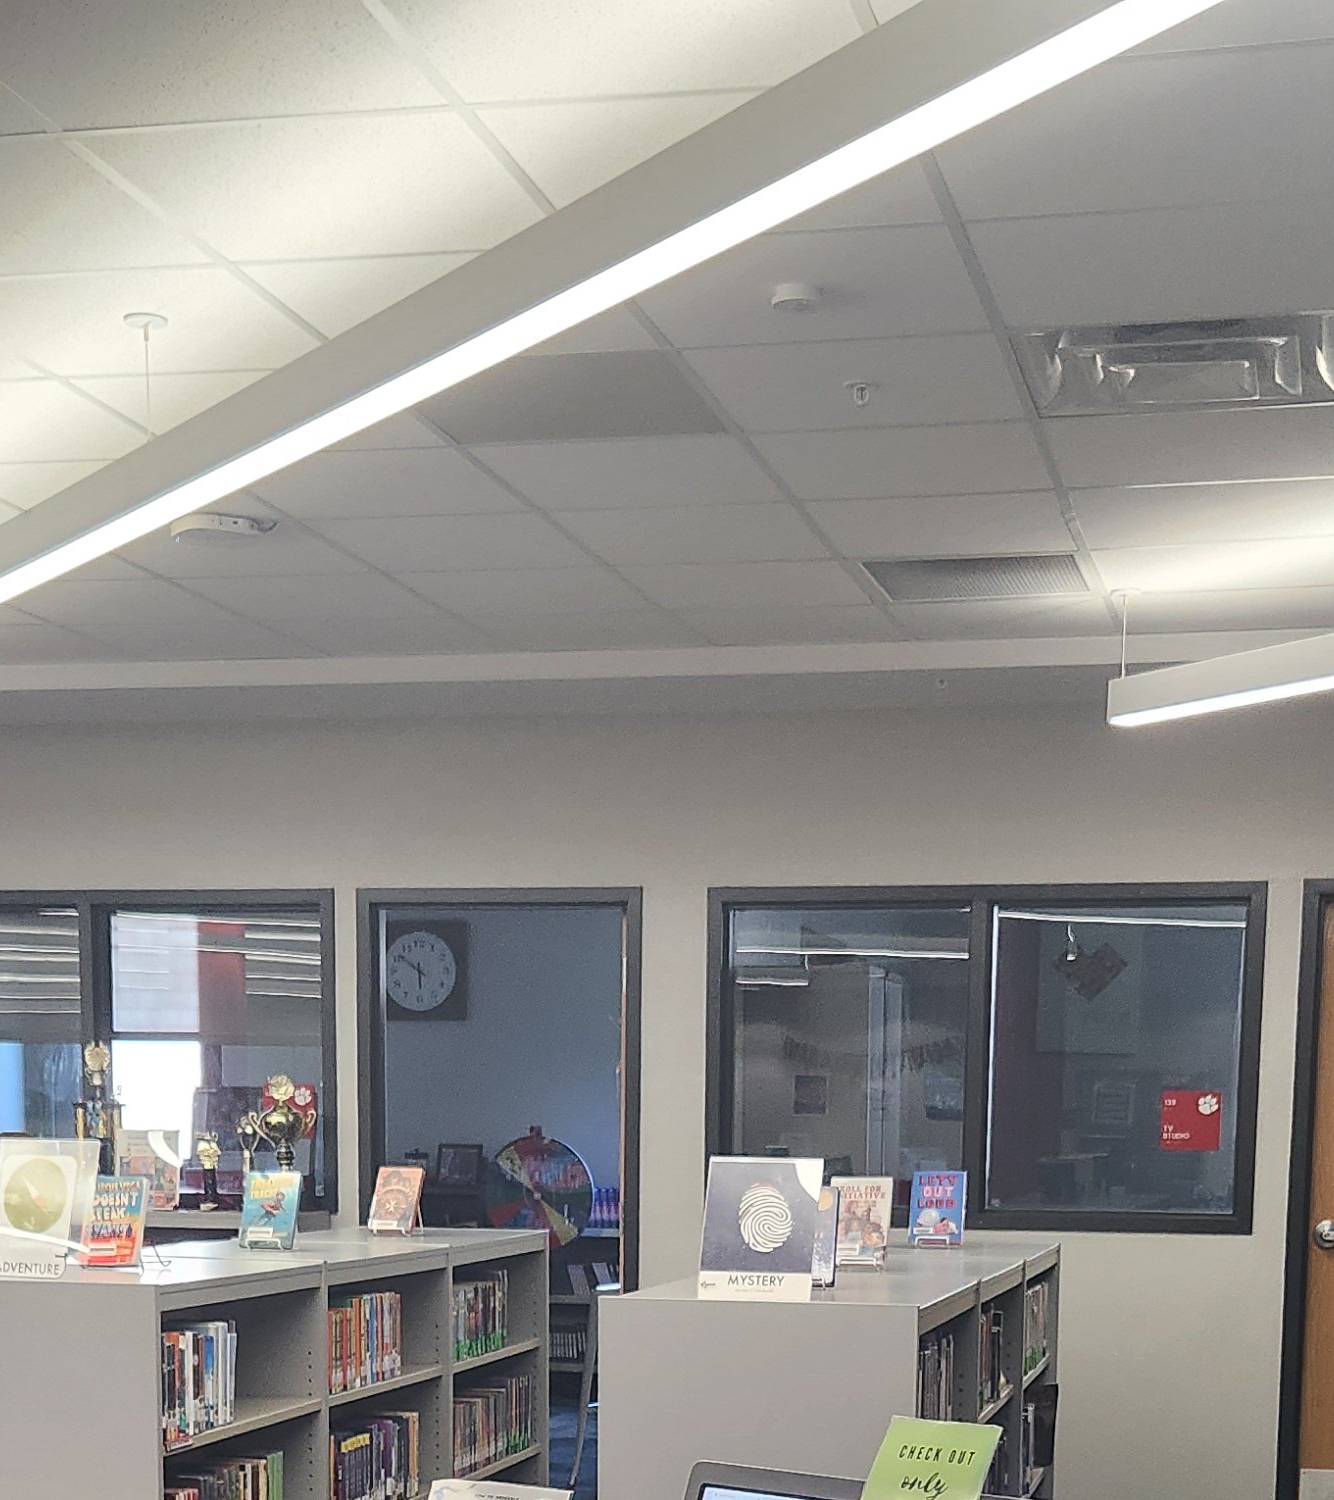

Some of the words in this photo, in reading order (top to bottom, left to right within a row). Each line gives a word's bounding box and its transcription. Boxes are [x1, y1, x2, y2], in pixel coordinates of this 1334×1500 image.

[840, 1192, 886, 1200] ITIATIVE
[923, 1186, 954, 1198] OUT
[728, 1275, 785, 1287] MYSTERY
[898, 1445, 943, 1462] CHECK
[948, 1449, 976, 1466] OUT
[900, 1472, 949, 1500] only
